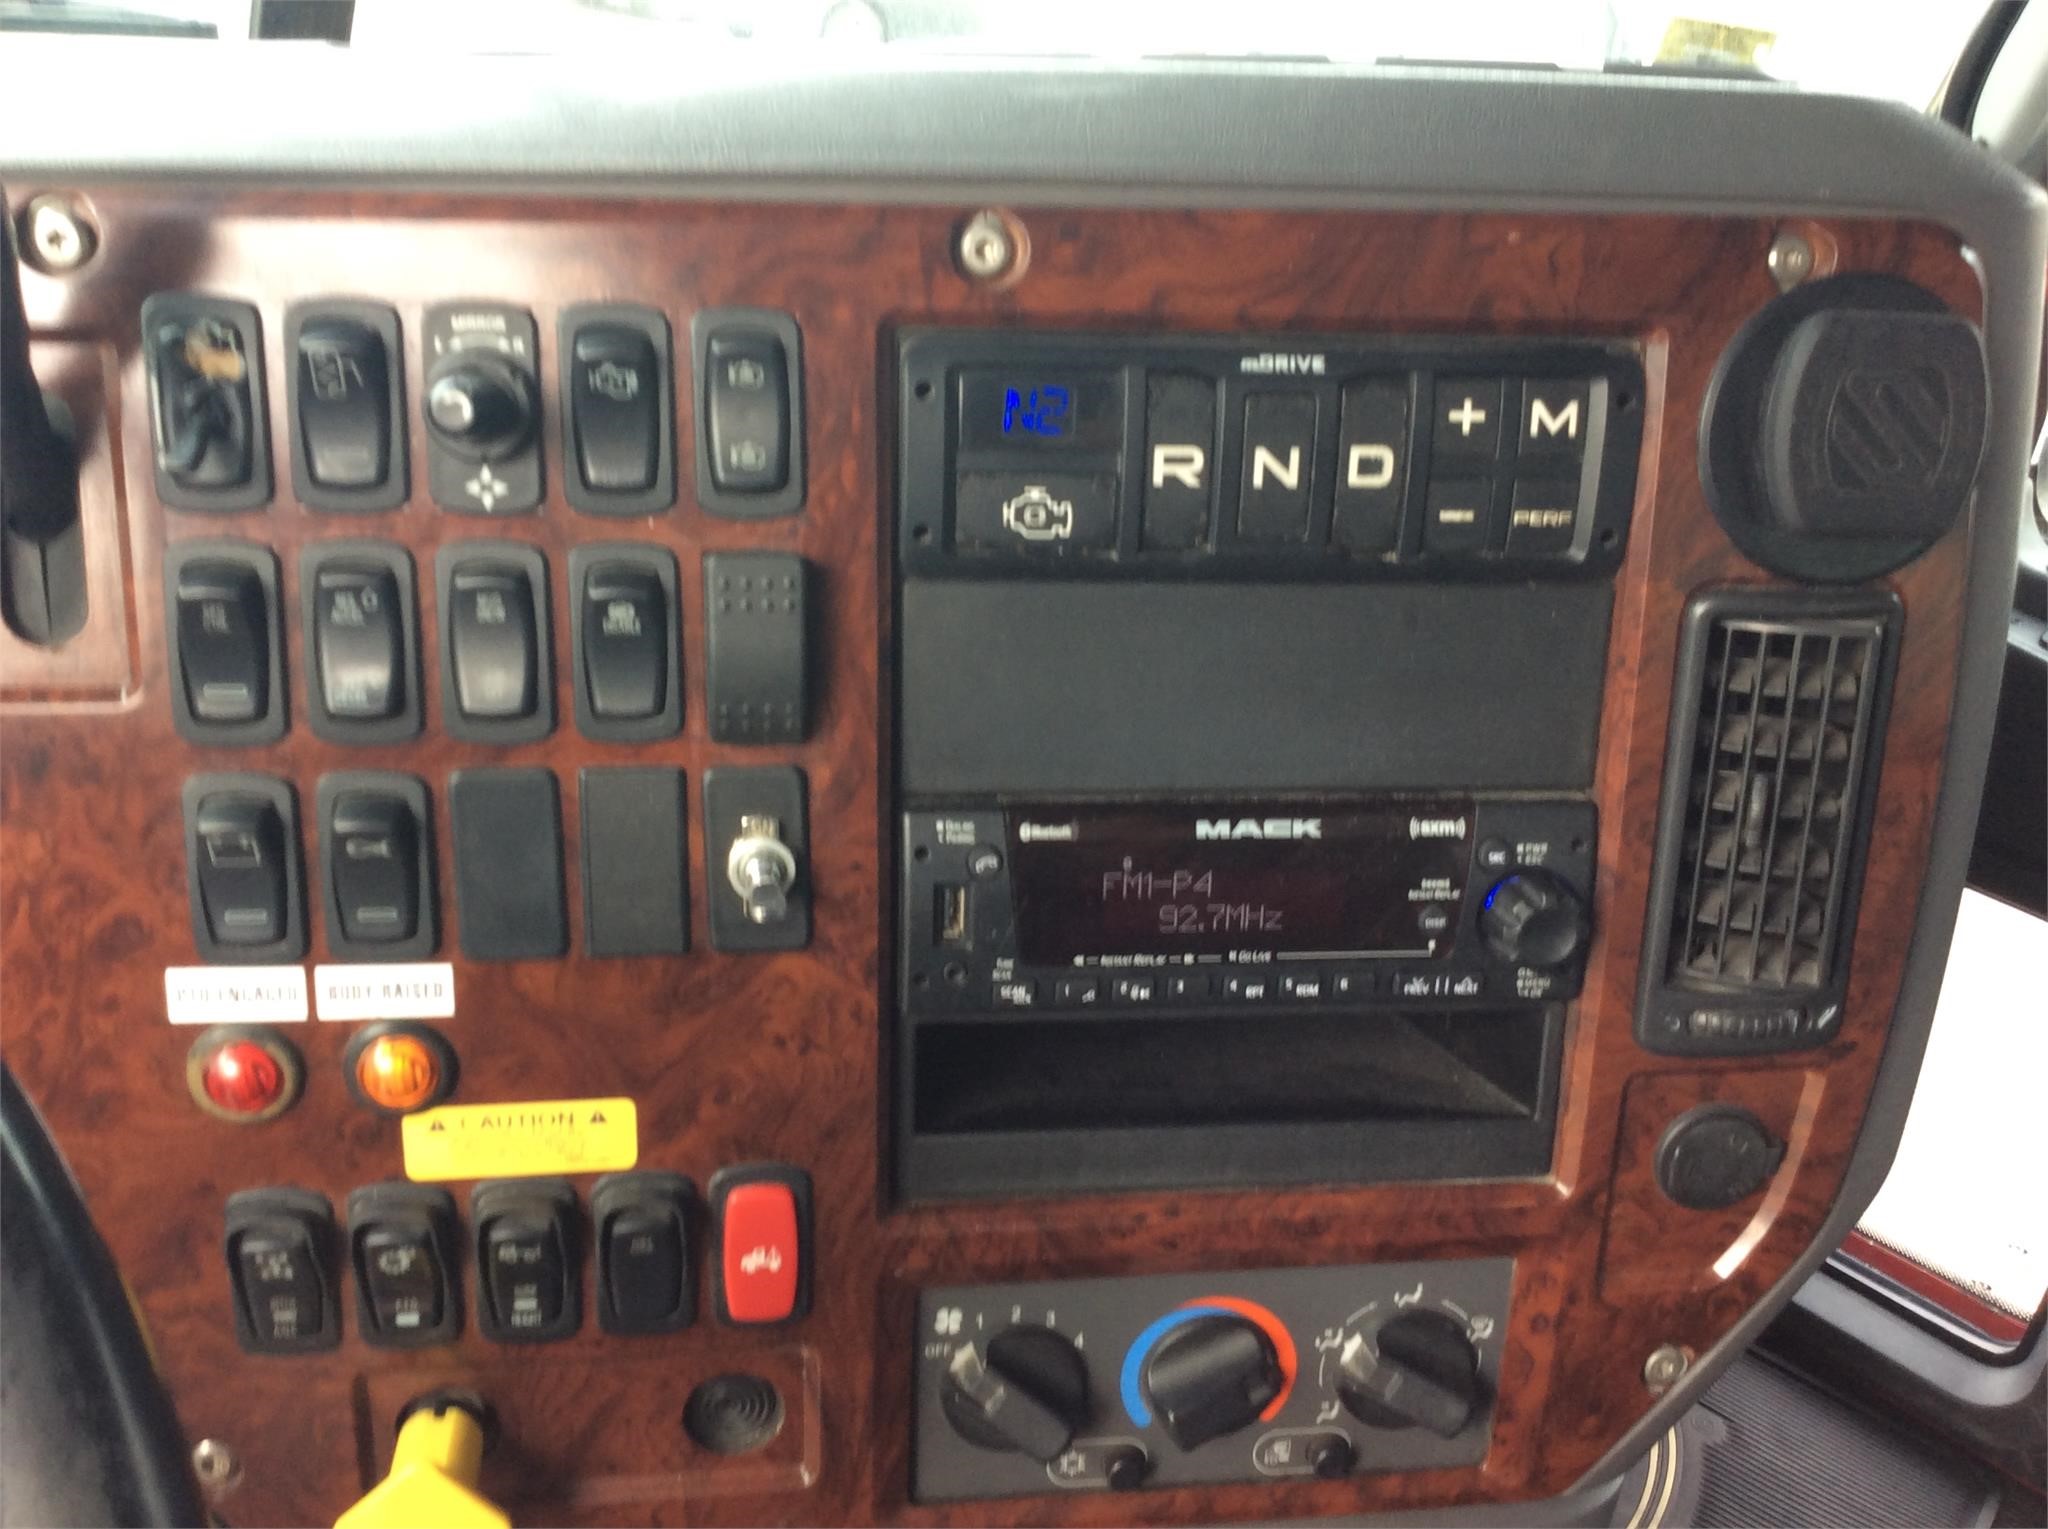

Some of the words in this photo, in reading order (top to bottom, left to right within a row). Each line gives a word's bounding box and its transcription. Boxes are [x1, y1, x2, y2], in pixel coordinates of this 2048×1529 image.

[1003, 384, 1070, 436] N2
[1529, 398, 1580, 439] M
[1152, 445, 1204, 489] R
[1253, 445, 1300, 490] N
[1347, 444, 1394, 489] D
[1513, 509, 1573, 528] PERF
[1195, 818, 1322, 840] MACK
[1158, 903, 1284, 934] 92.7MHz
